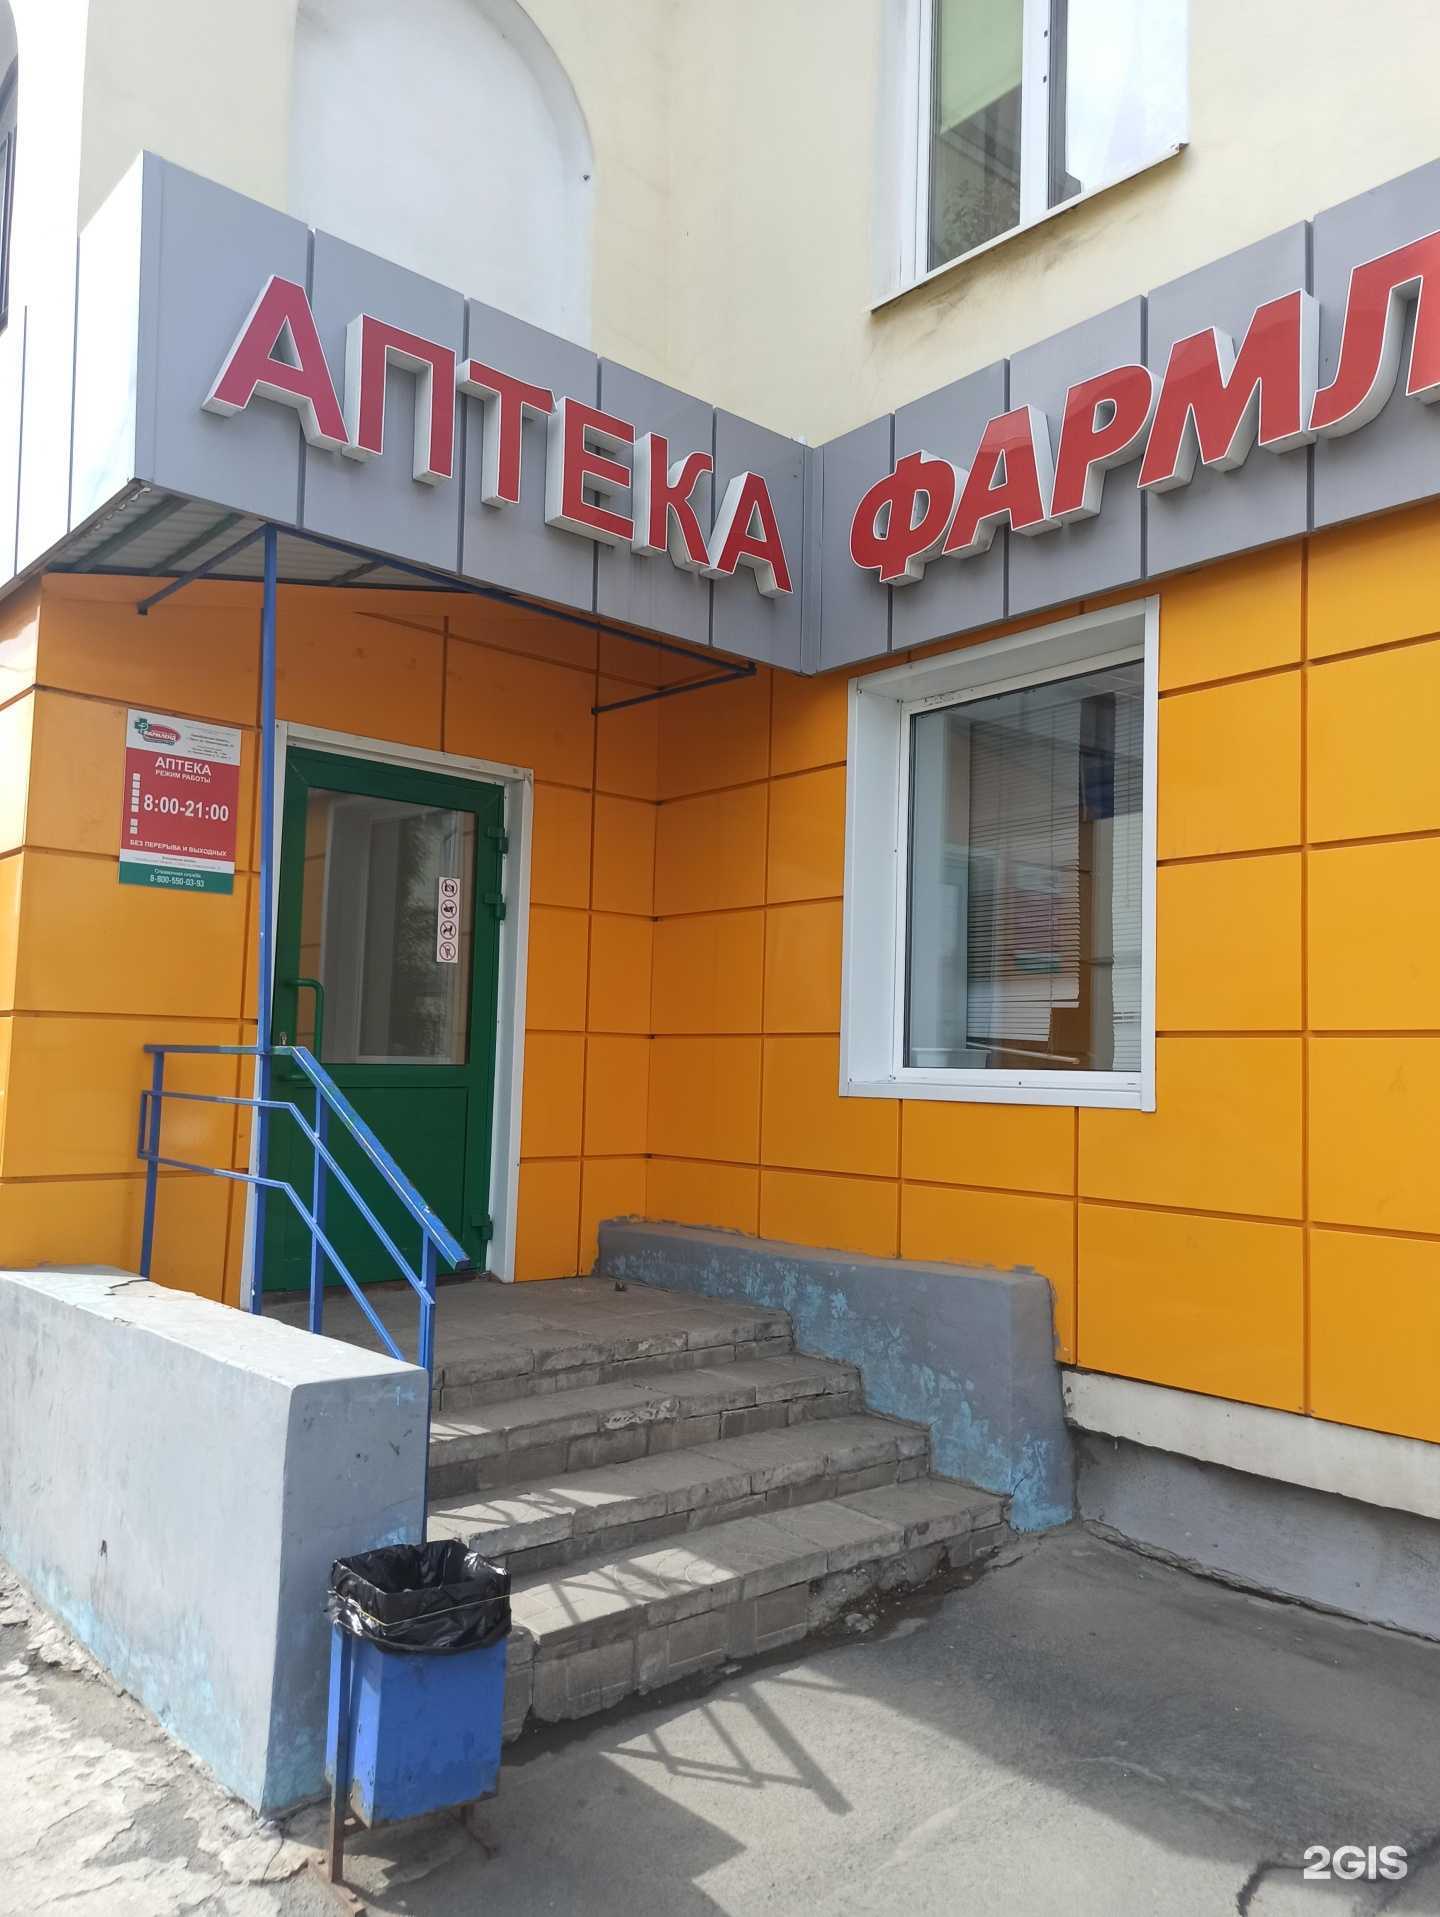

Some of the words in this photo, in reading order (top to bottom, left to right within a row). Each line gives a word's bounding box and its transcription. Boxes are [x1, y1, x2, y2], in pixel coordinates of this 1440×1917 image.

[201, 274, 794, 599] АПТЕКА
[155, 757, 212, 776] АПТЕКА
[155, 769, 181, 779] РЕЖИМ
[181, 774, 211, 784] РАБОТЫ
[144, 794, 229, 822] 8:00-21:00
[145, 841, 182, 851] ПЕРЕРЫВА
[189, 847, 228, 857] ВЫХОДНЫХ
